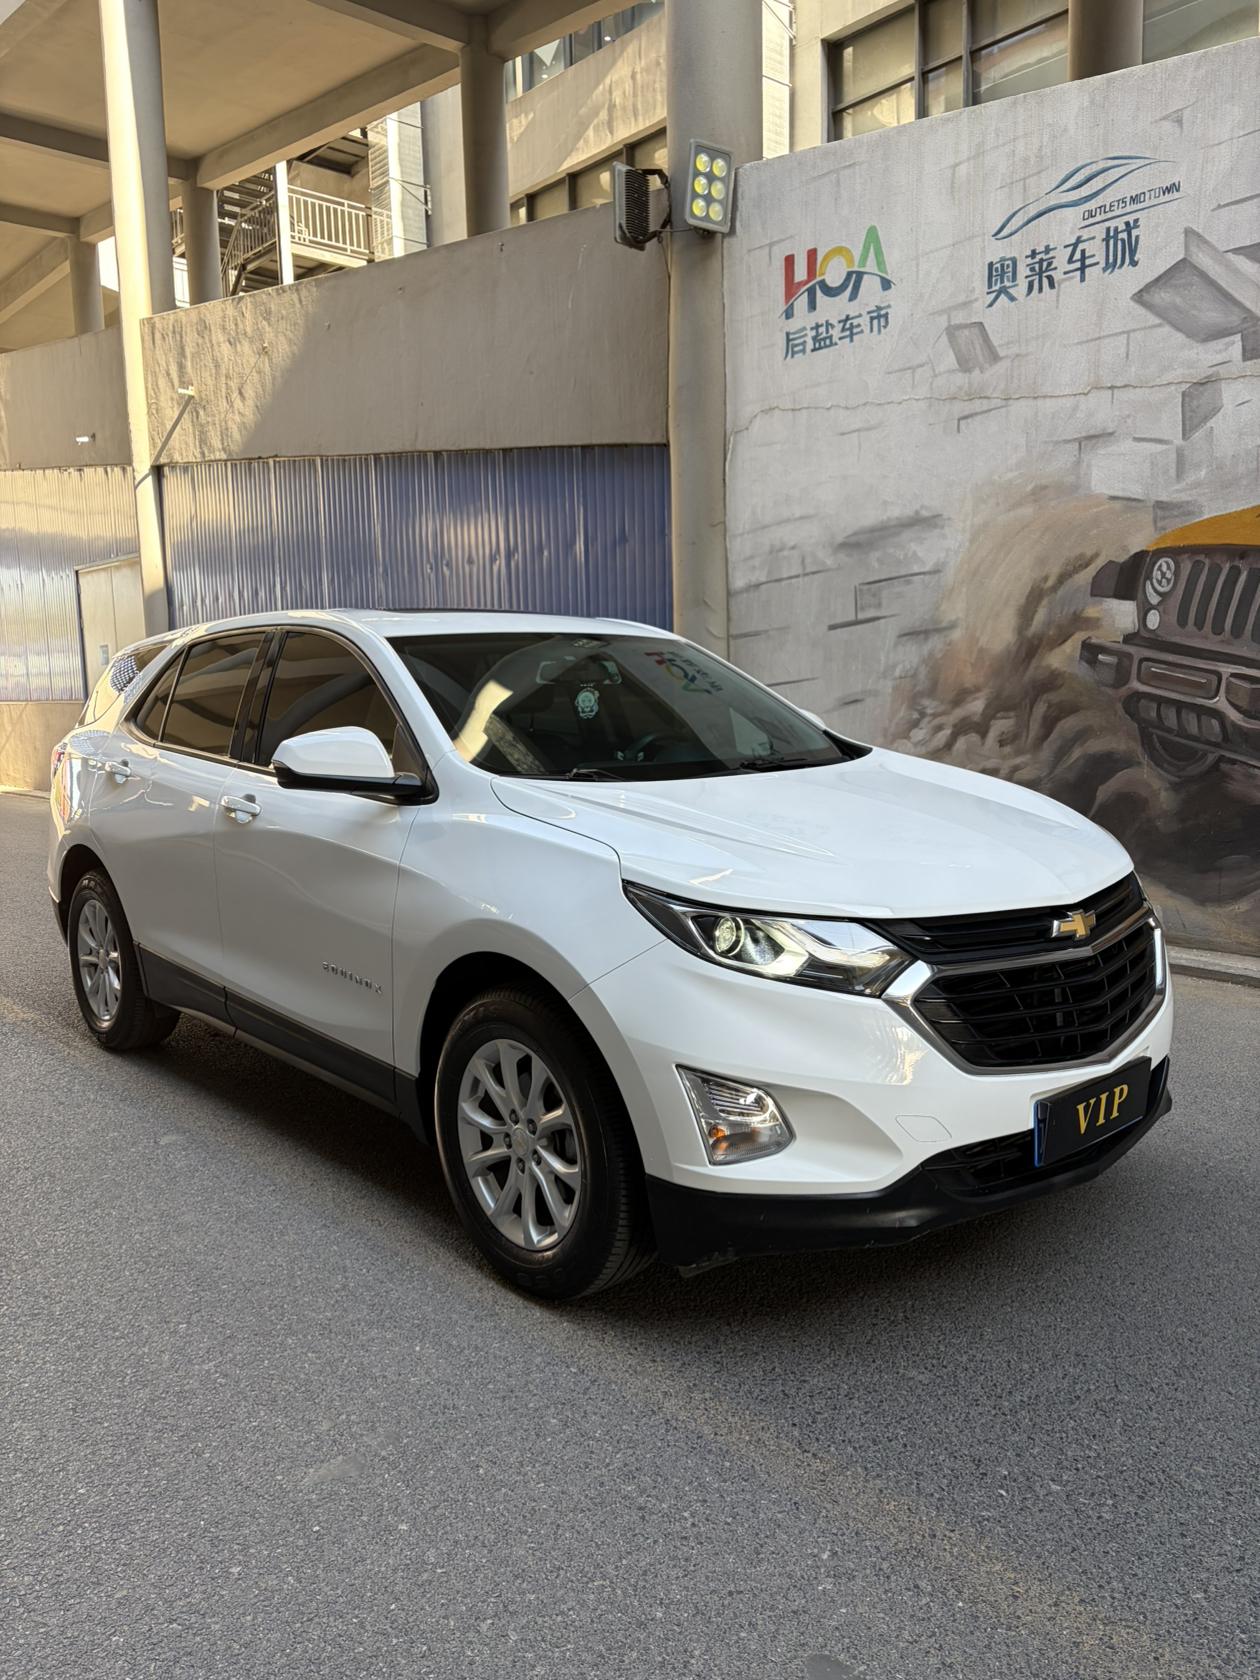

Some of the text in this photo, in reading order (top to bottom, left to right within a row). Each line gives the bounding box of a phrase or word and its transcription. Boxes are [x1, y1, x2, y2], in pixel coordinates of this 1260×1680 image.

[1082, 195, 1128, 221] OUTLETS
[782, 224, 893, 320] HOA
[985, 217, 1141, 309] 奥莱车城
[784, 303, 892, 360] 后盐车市
[1076, 1084, 1129, 1135] VIP
